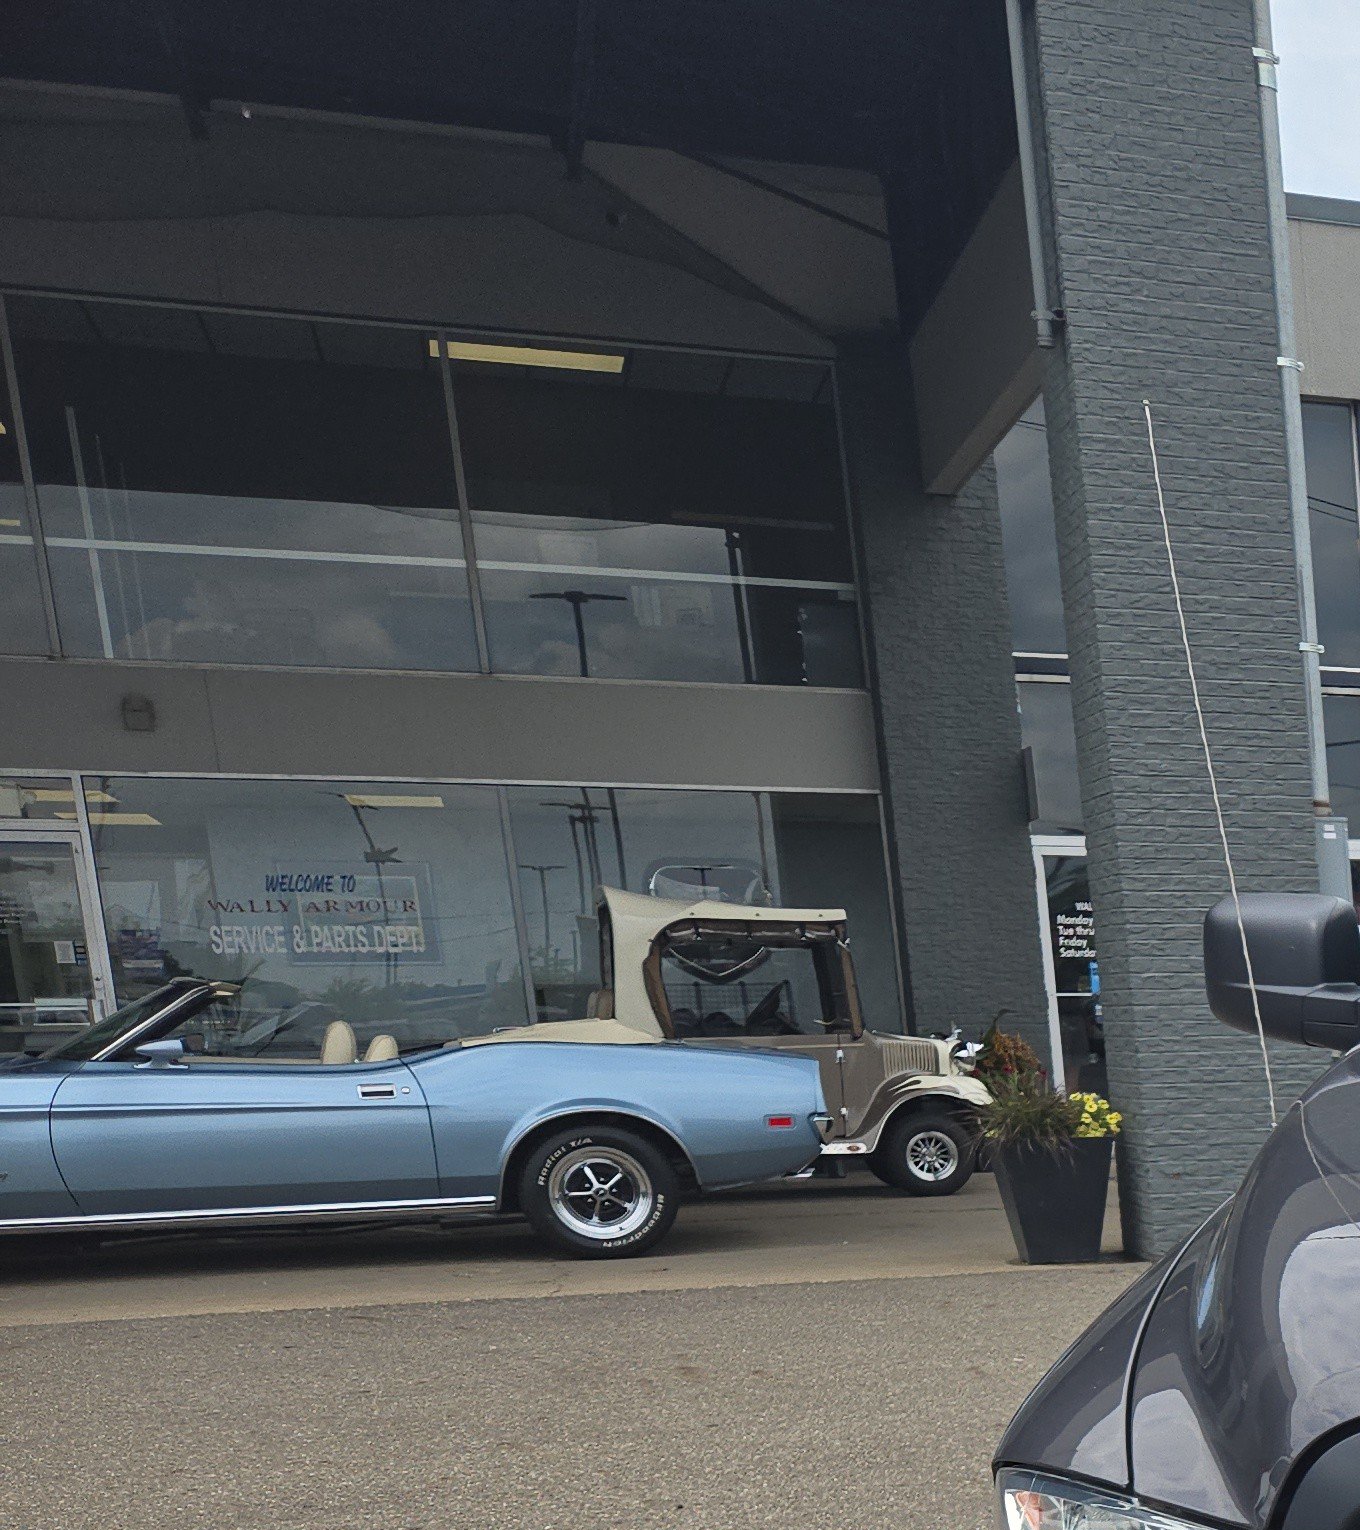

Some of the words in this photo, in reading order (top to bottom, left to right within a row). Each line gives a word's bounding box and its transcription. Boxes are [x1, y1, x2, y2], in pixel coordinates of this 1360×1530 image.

[265, 874, 334, 893] WELCOME
[339, 874, 356, 893] TO
[207, 899, 290, 914] WALLY
[304, 899, 418, 913] ARMOUR
[1056, 914, 1093, 927] Monday
[1057, 926, 1074, 935] Tue
[209, 925, 288, 954] SERVICE
[292, 925, 306, 954] &
[312, 925, 369, 953] PARTS
[1058, 936, 1088, 948] Friday
[537, 1146, 567, 1187] Radial
